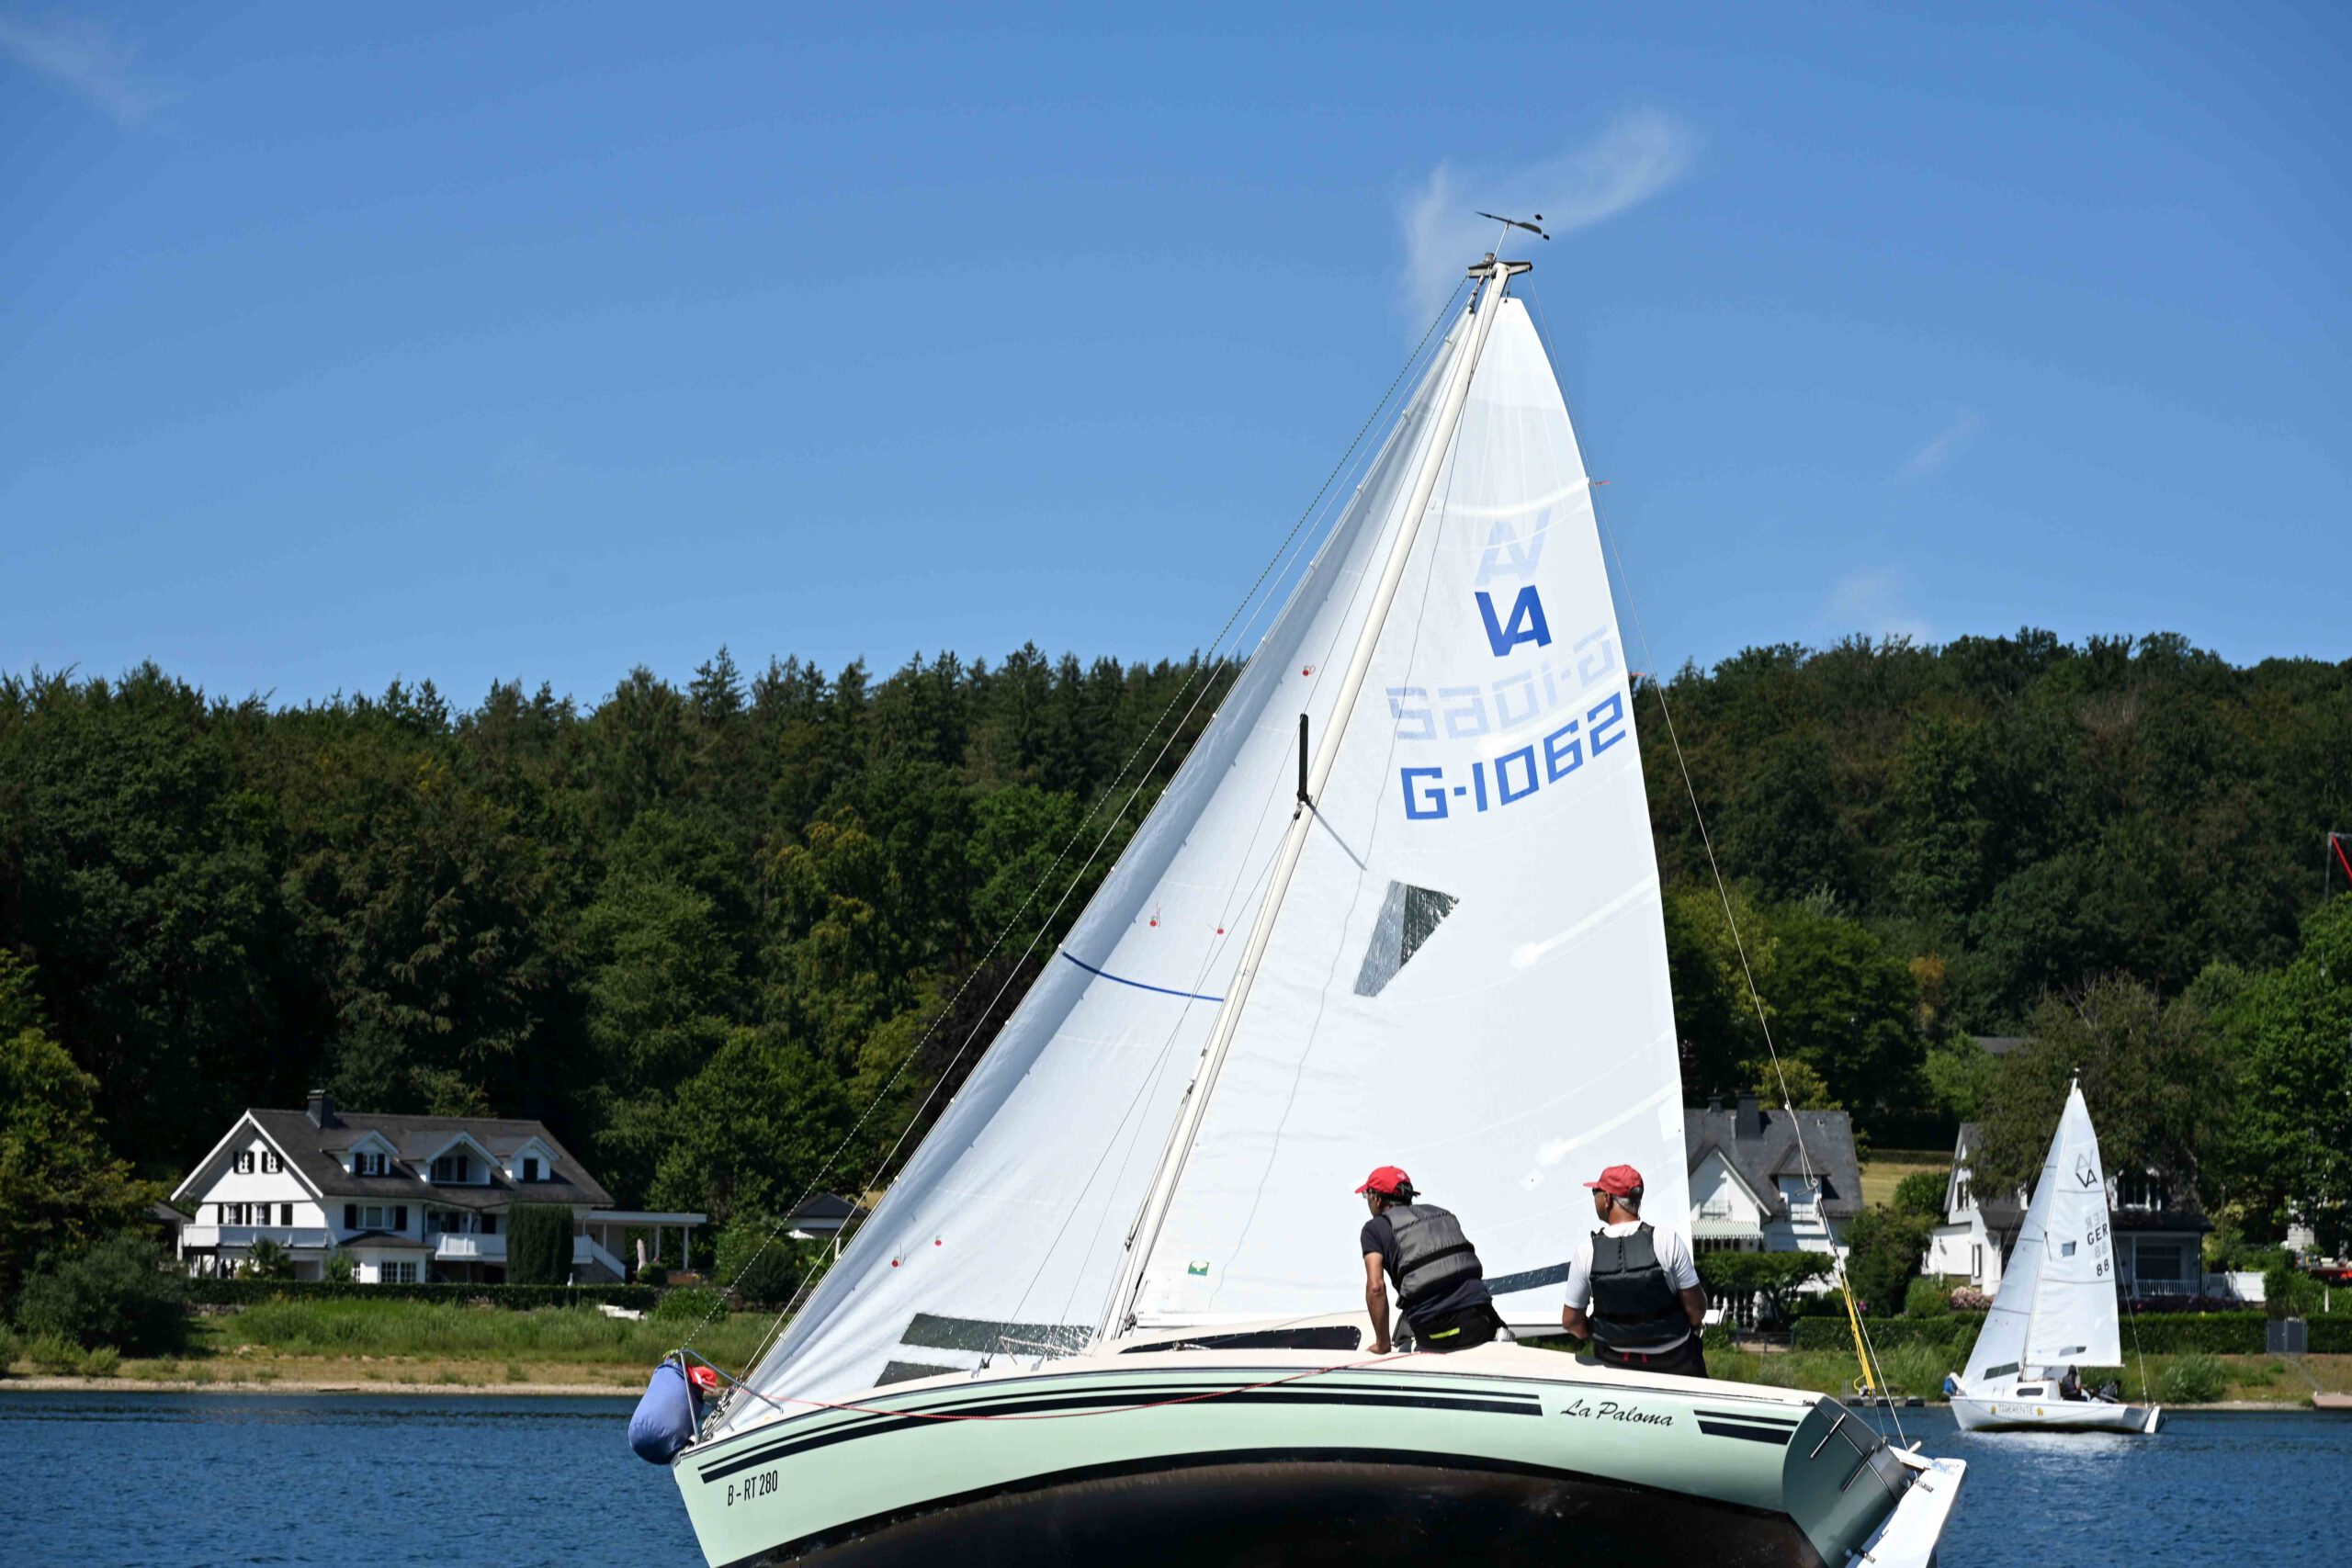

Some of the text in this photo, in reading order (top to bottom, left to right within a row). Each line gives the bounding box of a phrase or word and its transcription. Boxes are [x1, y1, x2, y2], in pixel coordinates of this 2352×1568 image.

[1475, 585, 1552, 657] VA
[1400, 692, 1626, 820] G-1062
[2086, 1224, 2108, 1246] GER
[2096, 1258, 2109, 1277] 88
[1560, 1399, 1674, 1427] La Paloma
[759, 1470, 778, 1496] 280
